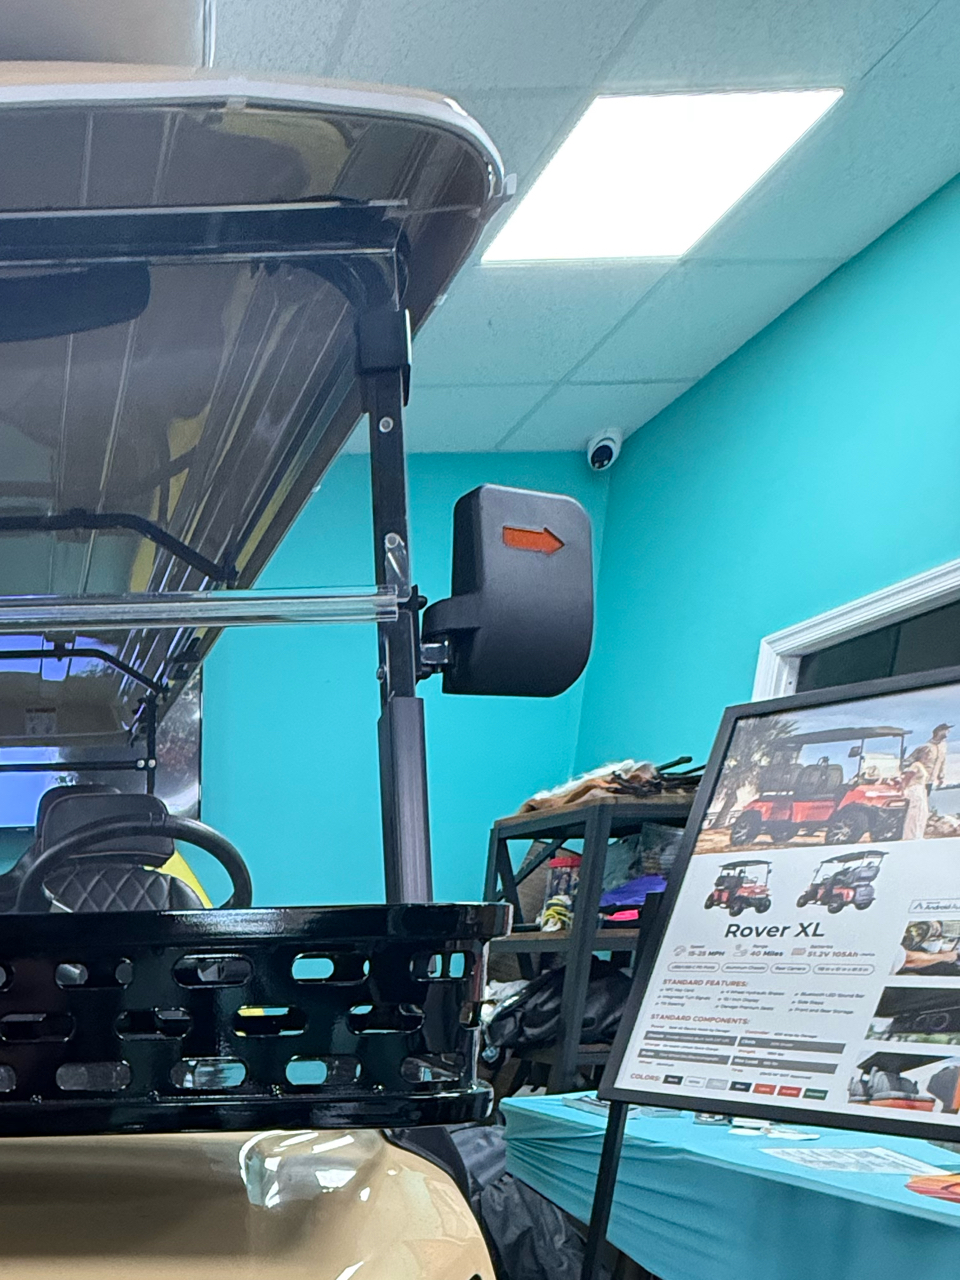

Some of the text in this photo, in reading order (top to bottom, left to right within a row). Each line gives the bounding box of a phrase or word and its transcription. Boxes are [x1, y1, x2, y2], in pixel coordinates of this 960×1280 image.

[725, 921, 825, 938] Rover XL
[692, 1016, 750, 1024] COMPONENTS:
[631, 1073, 660, 1081] COLORS:
